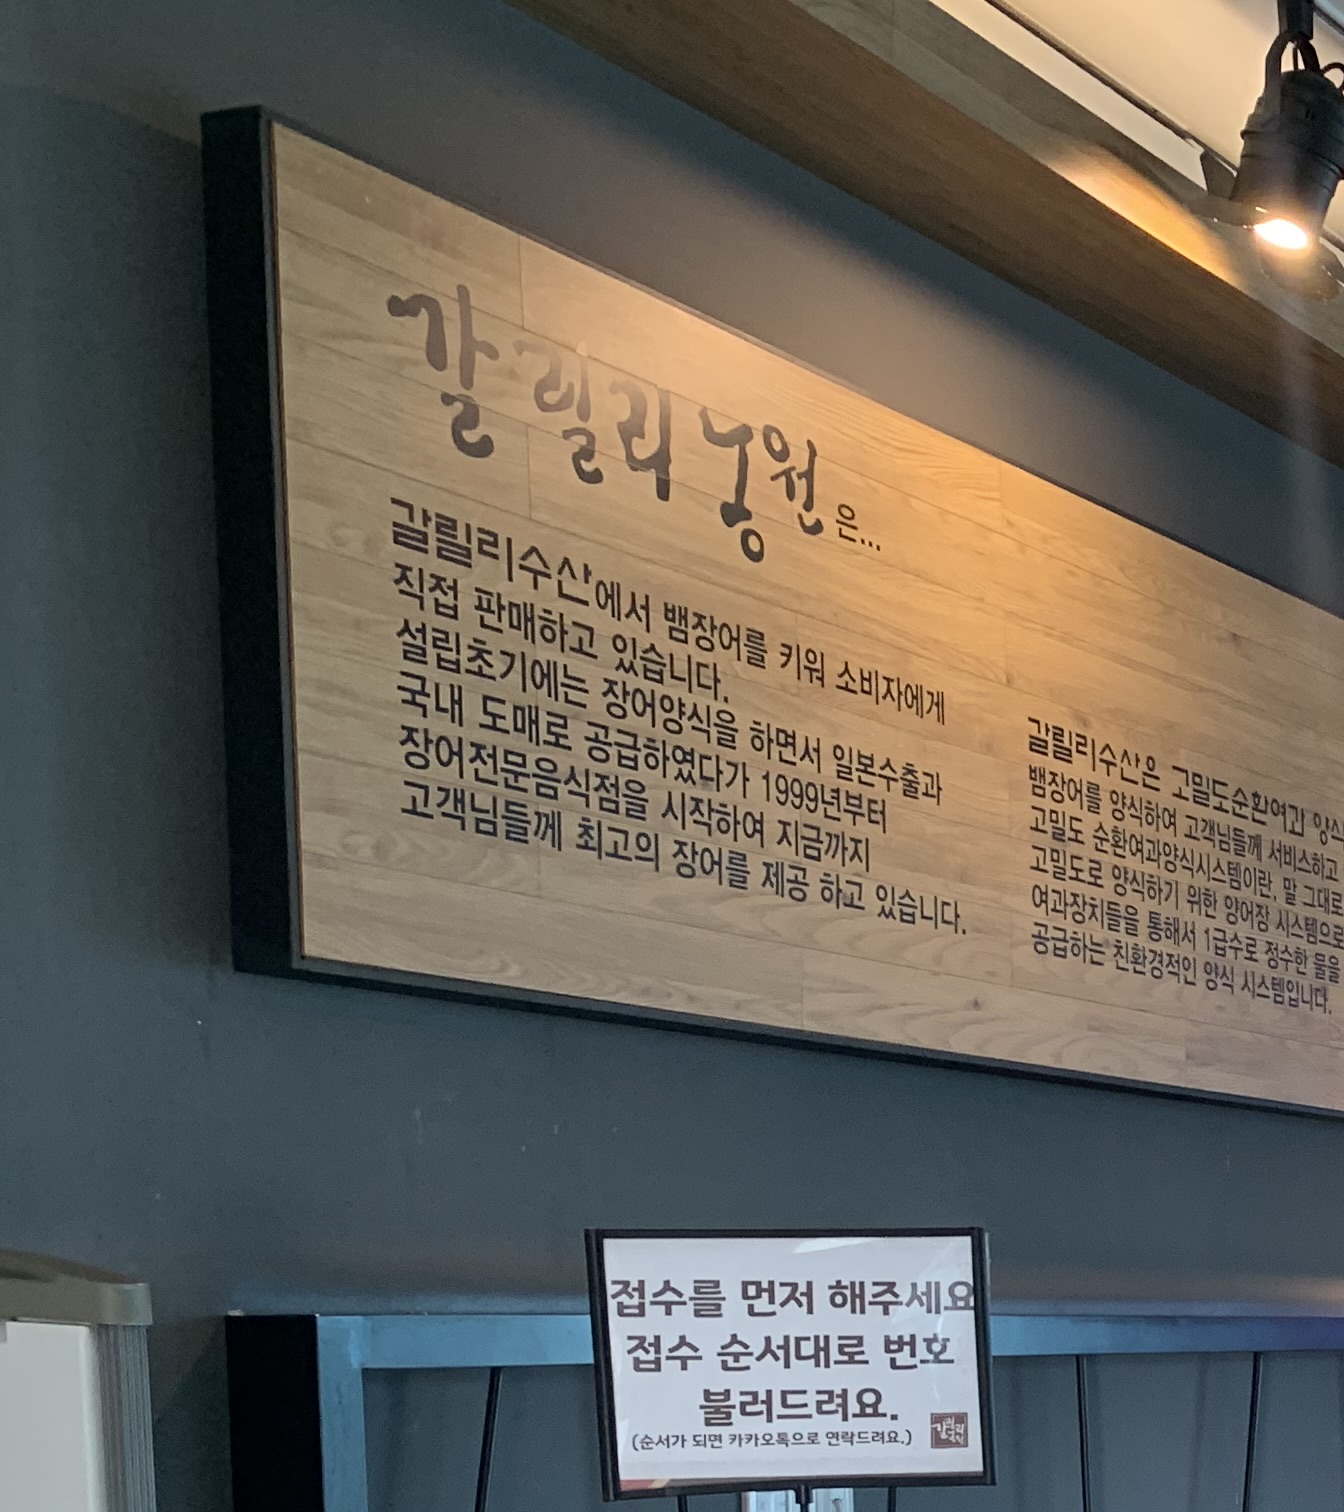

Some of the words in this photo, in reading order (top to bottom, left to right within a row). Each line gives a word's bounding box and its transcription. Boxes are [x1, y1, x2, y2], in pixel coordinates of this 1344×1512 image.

[391, 498, 650, 632] 갈릴리수산에서
[663, 602, 767, 669] 뱀장어를
[779, 642, 824, 688] 키워
[835, 660, 944, 725] 소비자에게
[393, 562, 458, 620] 직접
[474, 587, 597, 659] 판매하고
[611, 633, 728, 703] 있습니다.
[396, 619, 588, 708] 설립초기에는
[601, 677, 737, 749] 장어양식을
[749, 720, 820, 773] 하면서
[832, 744, 942, 805] 일본수출과
[396, 670, 463, 727] 국내
[478, 694, 571, 751] 도매로
[584, 721, 749, 798] 공급하였다가
[761, 770, 886, 833] 1999년부터
[1027, 716, 1160, 791] 갈릴리수산은
[400, 725, 648, 820] 장어전문음식점을
[661, 790, 764, 848] 시작하여
[776, 819, 869, 872] 지금까지
[1028, 764, 1101, 814] 뱀장어를
[1109, 789, 1176, 837] 양식하여
[1183, 814, 1261, 862] 고객님들께
[1268, 839, 1338, 881] 서비스하고
[401, 780, 561, 851] 고객님들께
[575, 816, 659, 872] 최고의
[672, 839, 750, 890] 장어를
[761, 861, 809, 902] 제공
[875, 884, 966, 934] 있습니다.
[1029, 805, 1084, 845] 고밀도
[1282, 876, 1297, 906] 말
[1302, 884, 1343, 916] 그대로
[1029, 844, 1104, 888] 고밀도로
[1111, 864, 1178, 910] 양식하기
[1186, 884, 1217, 919] 위한
[1224, 895, 1269, 932] 양어장
[1275, 909, 1344, 949] 시스템으로
[1031, 884, 1139, 936] 여과장치들을
[1147, 910, 1195, 951] 통해서
[1203, 927, 1258, 962] 1급수로
[1264, 940, 1307, 975] 정수한
[1313, 952, 1340, 983] 물을
[1031, 921, 1105, 966] 공급하는
[1113, 939, 1196, 986] 친환경적인
[610, 1279, 726, 1318] 접수를
[740, 1280, 814, 1317] 먼저
[828, 1279, 976, 1315] 해주세요
[626, 1335, 703, 1372] 접수
[717, 1334, 869, 1372] 순서대로
[885, 1334, 955, 1369] 번호
[632, 1432, 687, 1451] (순서가
[692, 1433, 723, 1449] 되면
[728, 1432, 821, 1448] 카카오톡으로
[826, 1430, 913, 1448] 연락드려요.)
[699, 1388, 899, 1427] 불러드려요.
